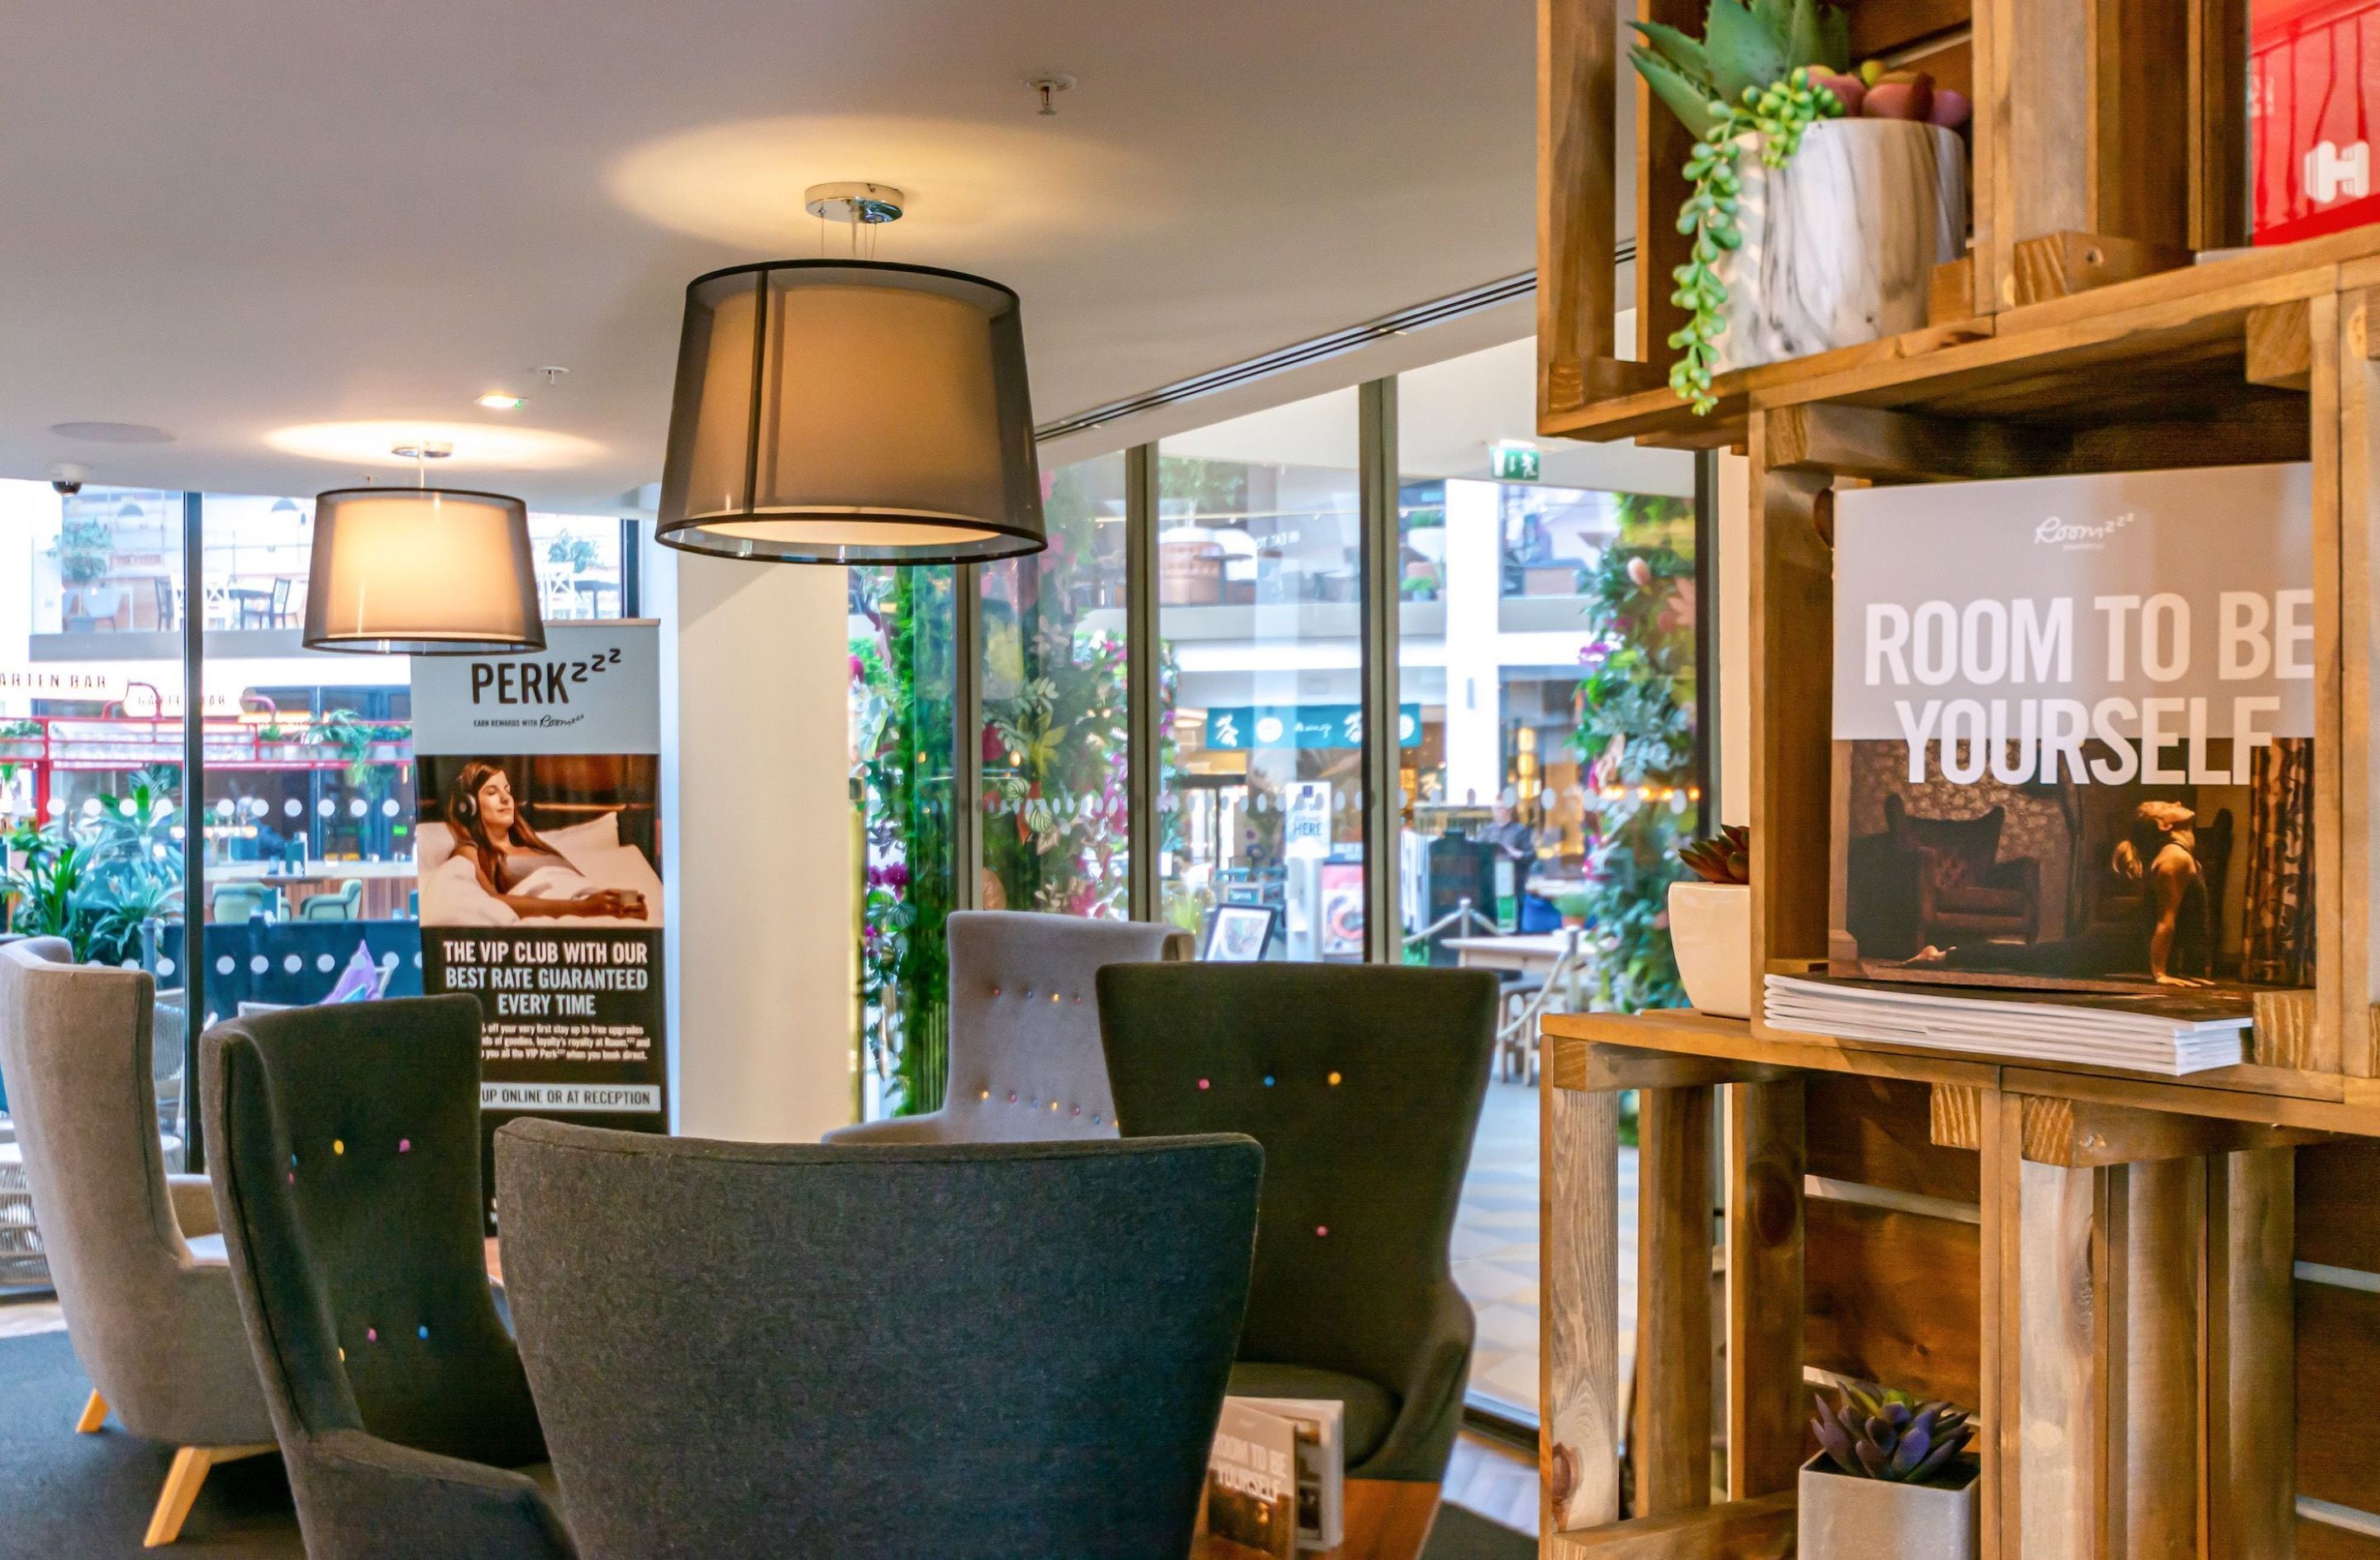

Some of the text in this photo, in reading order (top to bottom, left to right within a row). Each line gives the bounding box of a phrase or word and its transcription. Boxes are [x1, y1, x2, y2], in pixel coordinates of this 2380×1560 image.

[1864, 588, 2313, 685] ROOM TO BE
[1895, 696, 2280, 785] YOURSELF
[1294, 822, 1323, 835] HERE
[443, 940, 648, 965] THE VIP CLUB WITH OUR
[445, 967, 648, 991] BEST RATE GUARANTEED
[498, 994, 596, 1016] EVERY TIME
[488, 1024, 499, 1034] off
[501, 1025, 516, 1036] your
[518, 1025, 536, 1036] very
[536, 1024, 552, 1034] first
[553, 1025, 569, 1036] stay
[571, 1026, 581, 1036] up
[582, 1025, 590, 1034] to
[591, 1024, 607, 1034] free
[608, 1025, 645, 1037] upgrades
[494, 1035, 502, 1046] of
[595, 1037, 603, 1047] at
[486, 1049, 500, 1060] you
[512, 1049, 524, 1058] the
[526, 1049, 538, 1058] VIP
[566, 1050, 587, 1059] when
[588, 1050, 602, 1062] you
[602, 1049, 621, 1059] book
[482, 1089, 650, 1106] UP ONLINE OR AT RECEPTION
